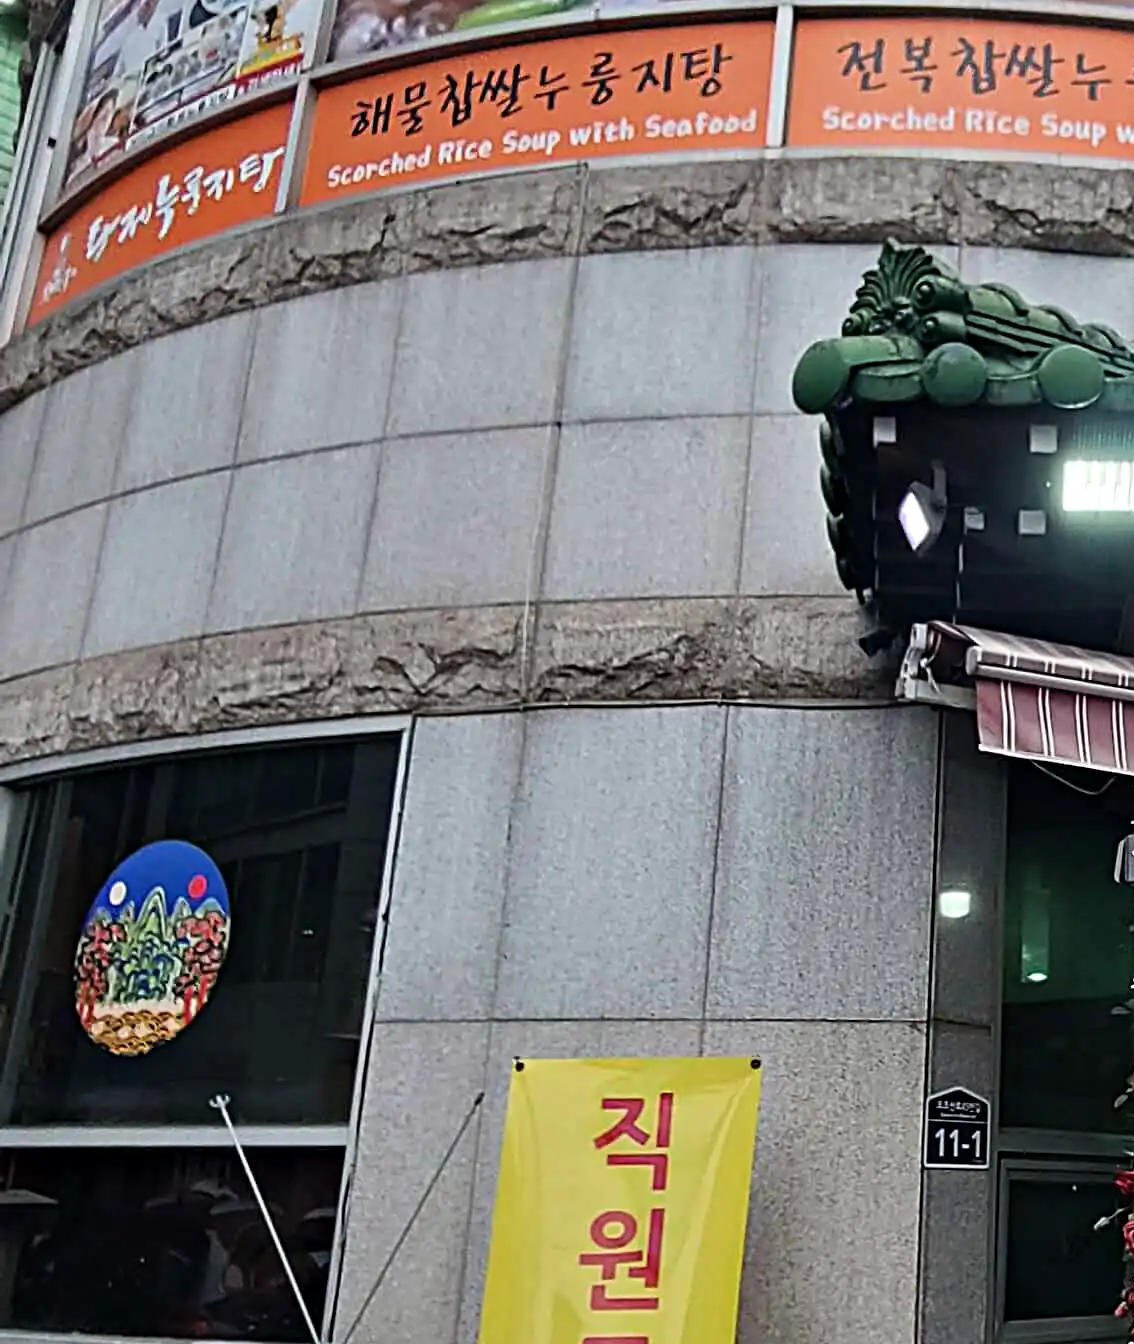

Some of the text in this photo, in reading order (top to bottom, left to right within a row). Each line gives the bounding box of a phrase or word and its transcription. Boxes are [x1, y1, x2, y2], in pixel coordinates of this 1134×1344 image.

[350, 43, 733, 138] 해물찹쌀누룽지탕
[327, 109, 757, 188] Scorched Rice Soup with Seafood
[822, 106, 956, 133] Scorched
[964, 108, 1030, 137] Rice
[1041, 113, 1108, 146] Soup
[935, 1128, 981, 1157] 11-1
